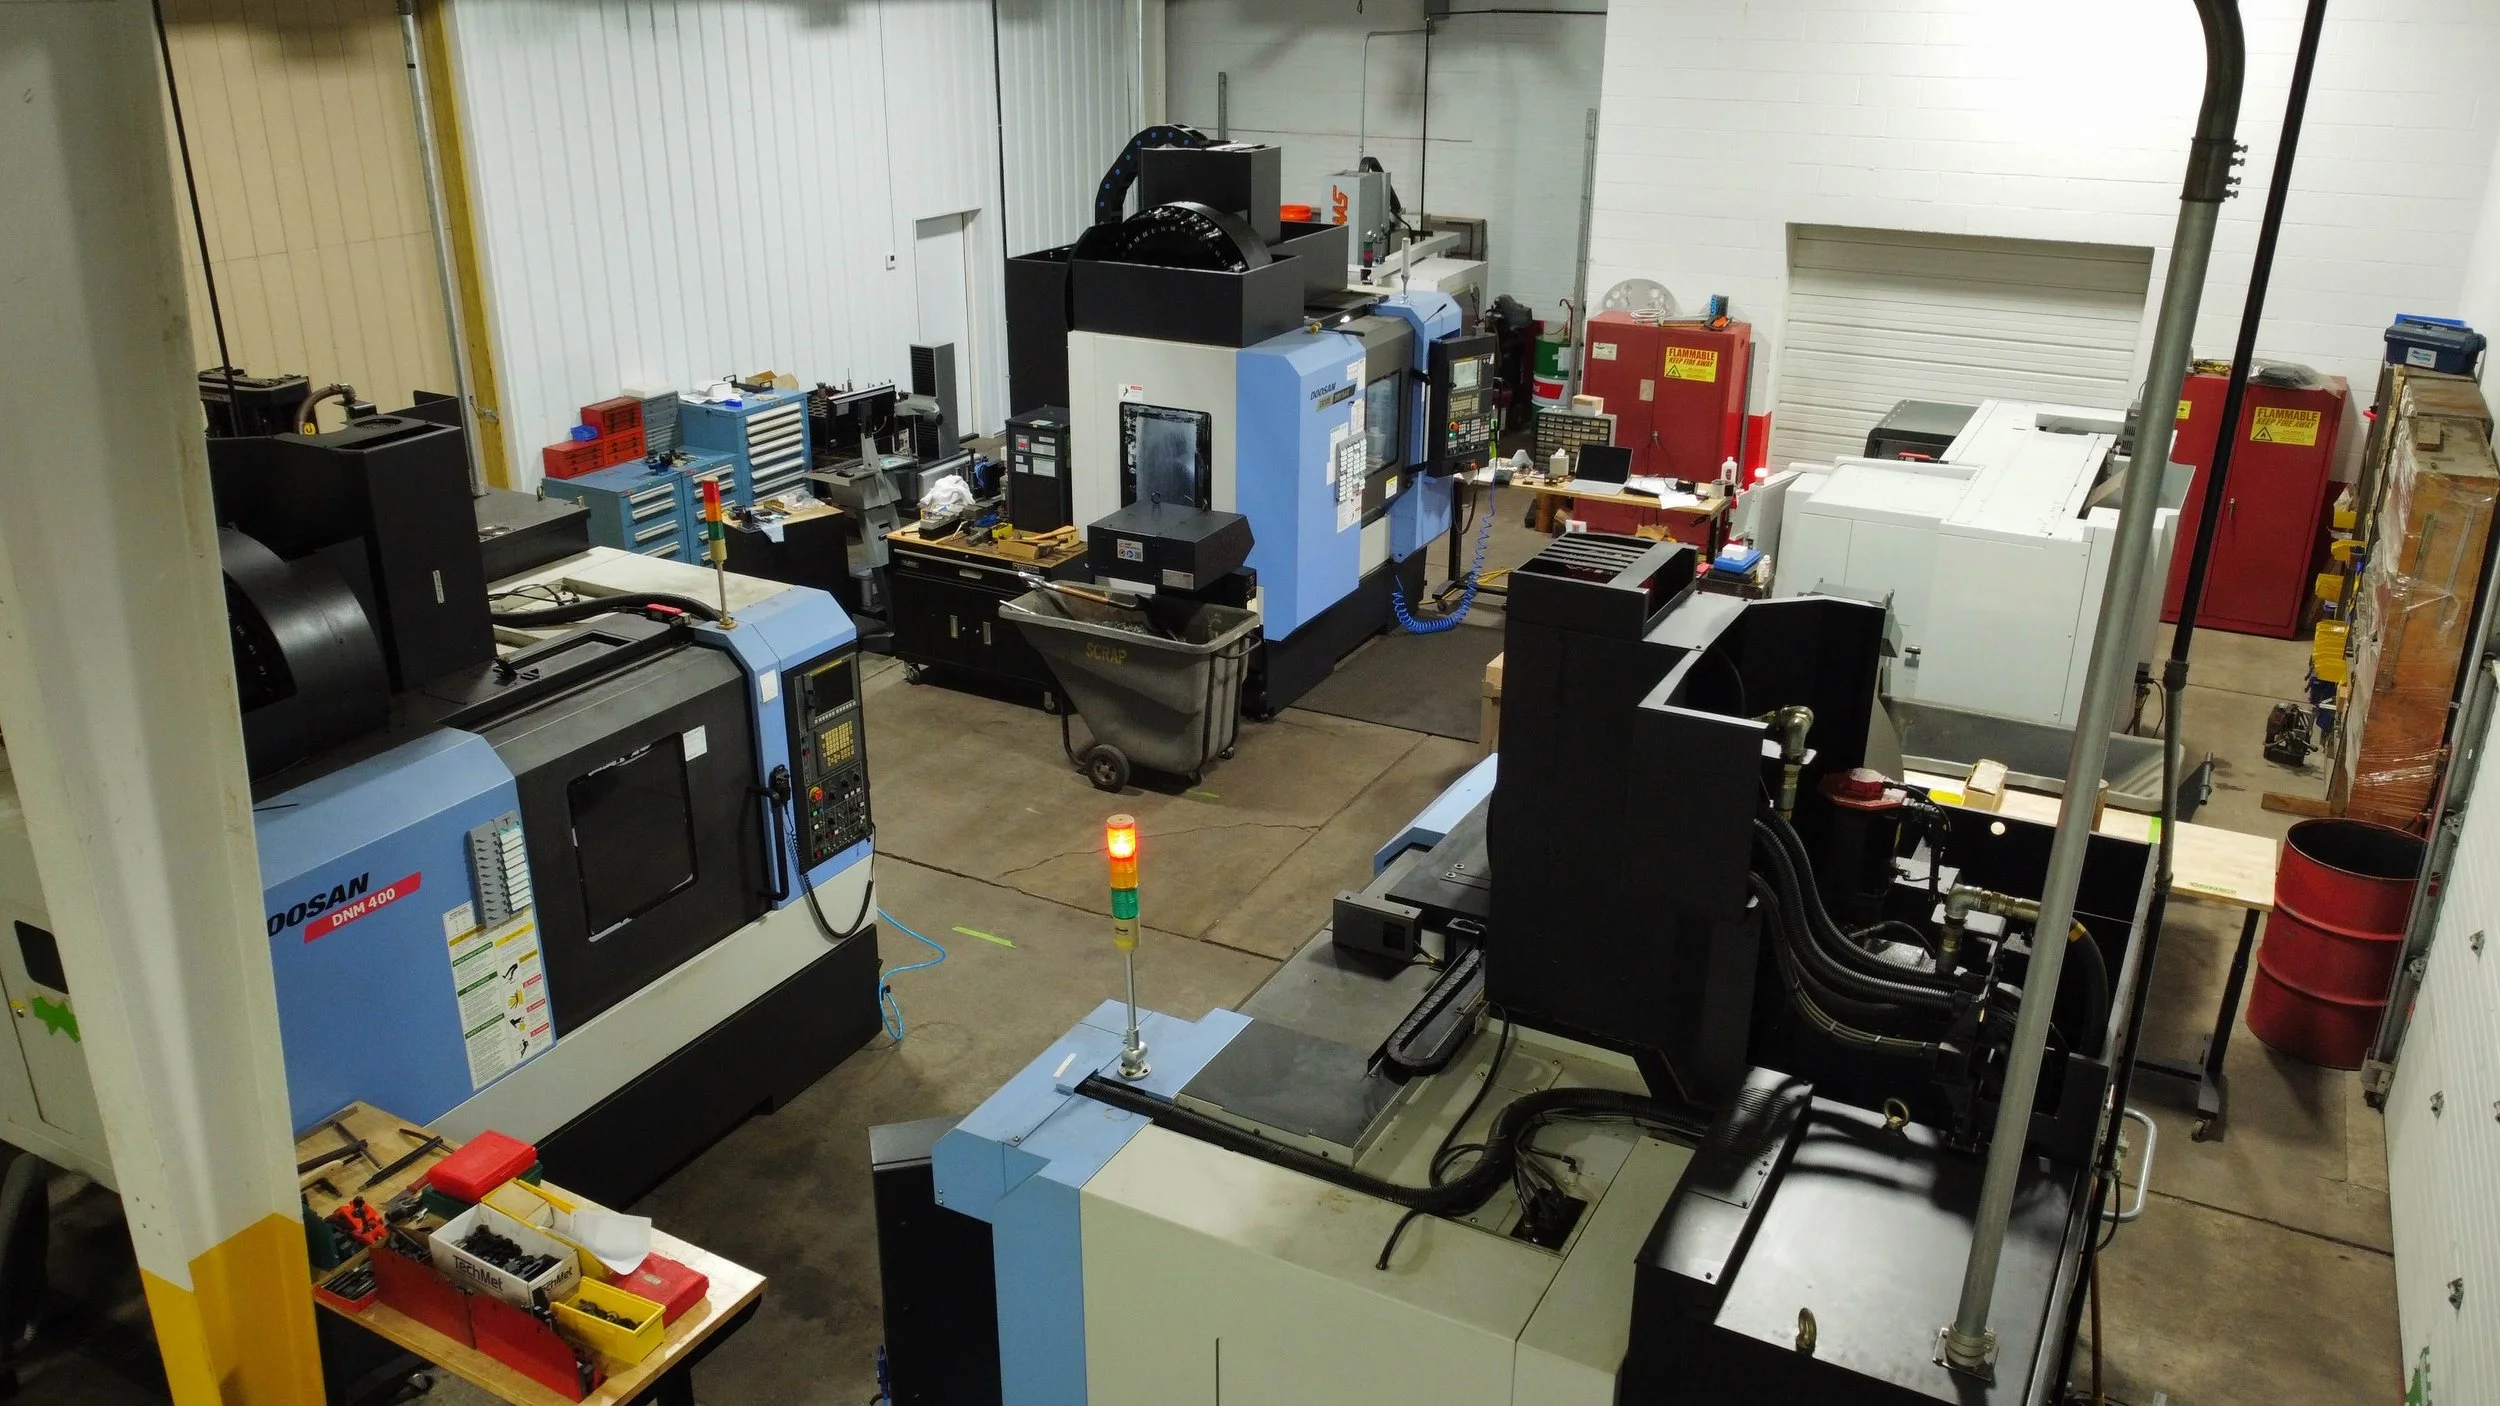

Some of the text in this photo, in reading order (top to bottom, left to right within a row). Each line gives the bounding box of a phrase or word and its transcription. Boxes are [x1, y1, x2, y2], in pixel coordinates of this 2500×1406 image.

[1669, 348, 1715, 361] FLAMMABLE
[1310, 381, 1336, 400] DOOSAN
[2256, 417, 2316, 429] KEEP FIRE AWAY
[2257, 408, 2318, 422] FLAMMABLE
[1086, 642, 1128, 664] SCRAP
[267, 871, 370, 937] OOSAN
[332, 888, 396, 927] DNM 400
[452, 1254, 504, 1291] TechMet
